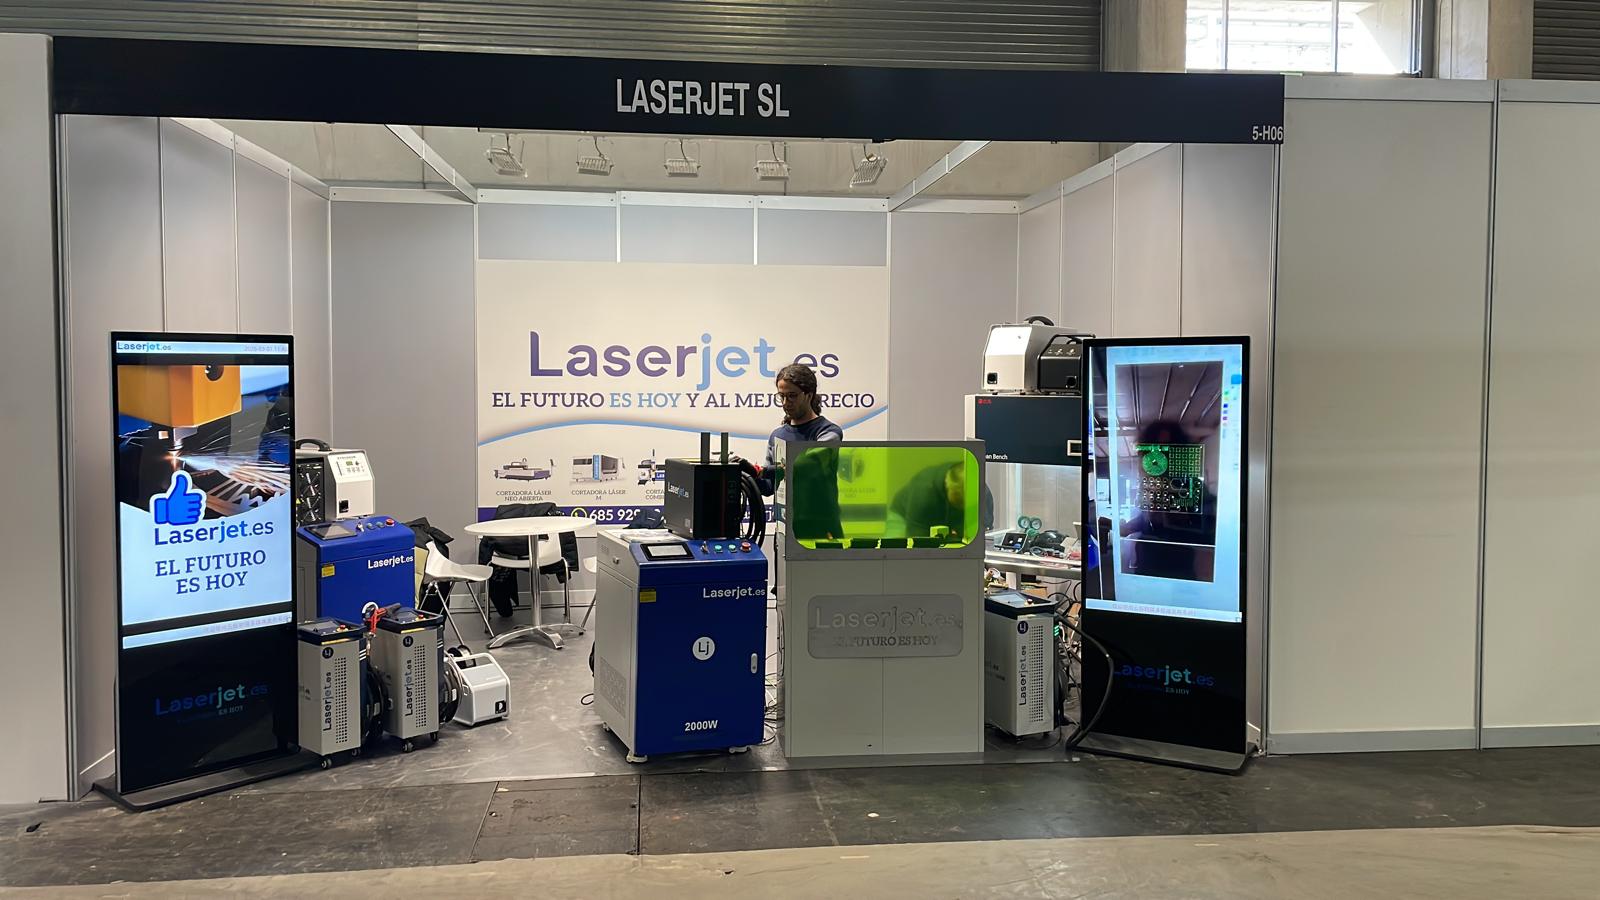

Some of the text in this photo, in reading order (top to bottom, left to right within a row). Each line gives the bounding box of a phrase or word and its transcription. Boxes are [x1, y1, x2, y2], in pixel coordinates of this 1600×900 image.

[616, 78, 790, 117] LASERJET SL
[1252, 125, 1284, 141] 5-H06
[530, 331, 840, 391] Laserjetes
[492, 392, 875, 408] EL FUTURO ES HOY Y AL MEJO RECIO
[589, 509, 614, 521] 685
[154, 521, 274, 545] Laserjet.es
[155, 550, 266, 577] EL FUTURO
[367, 555, 414, 569] Laserjet.es
[176, 571, 249, 595] ES HOY
[703, 586, 766, 600] Laserjet.es
[698, 641, 710, 655] Lj
[685, 720, 718, 731] 2000W
